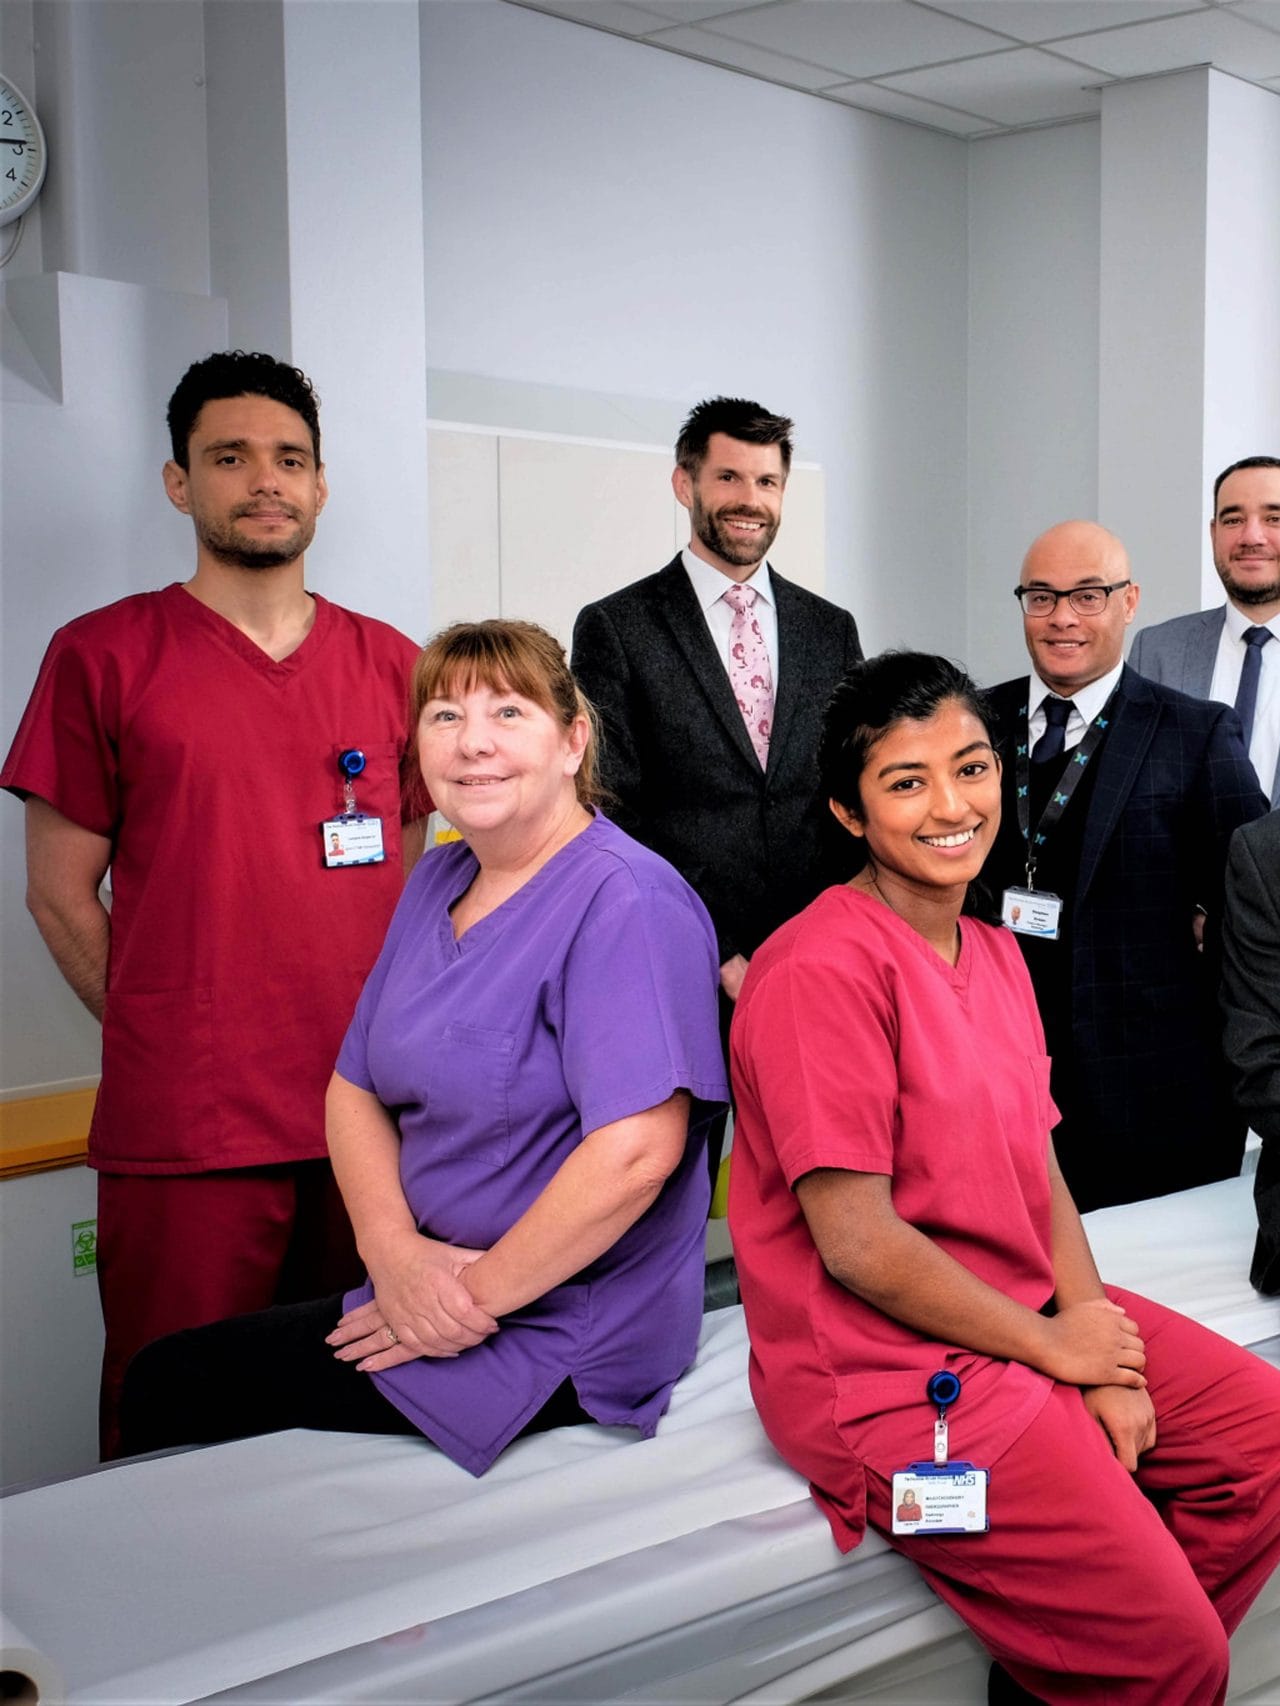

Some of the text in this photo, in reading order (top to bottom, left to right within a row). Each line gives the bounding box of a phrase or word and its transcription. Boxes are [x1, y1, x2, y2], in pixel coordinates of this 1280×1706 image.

[2, 110, 13, 126] 2
[5, 167, 17, 182] 4
[952, 1473, 976, 1487] NHS
